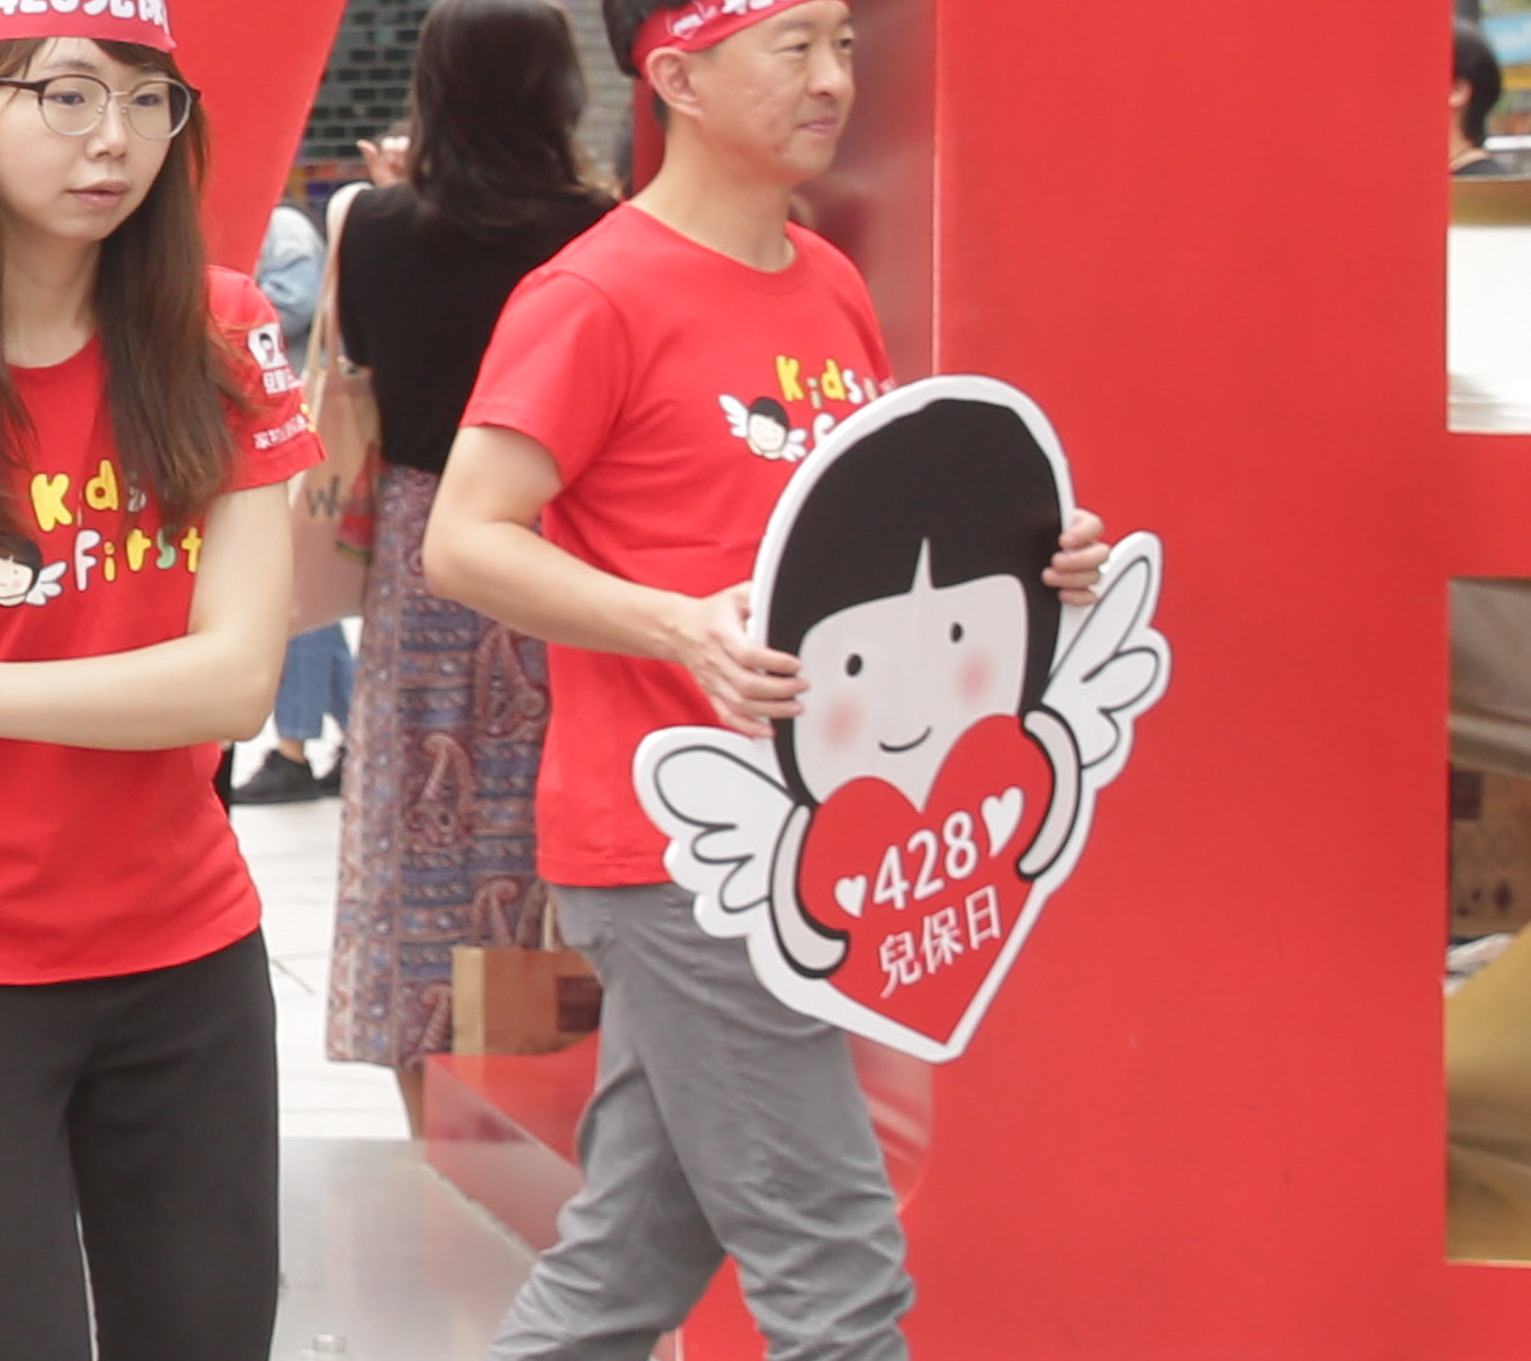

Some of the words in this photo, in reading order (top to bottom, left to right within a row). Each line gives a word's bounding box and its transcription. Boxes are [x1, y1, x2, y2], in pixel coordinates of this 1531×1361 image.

[74, 529, 203, 592] First
[872, 811, 978, 911] 428
[878, 885, 1003, 999] 兒保日
